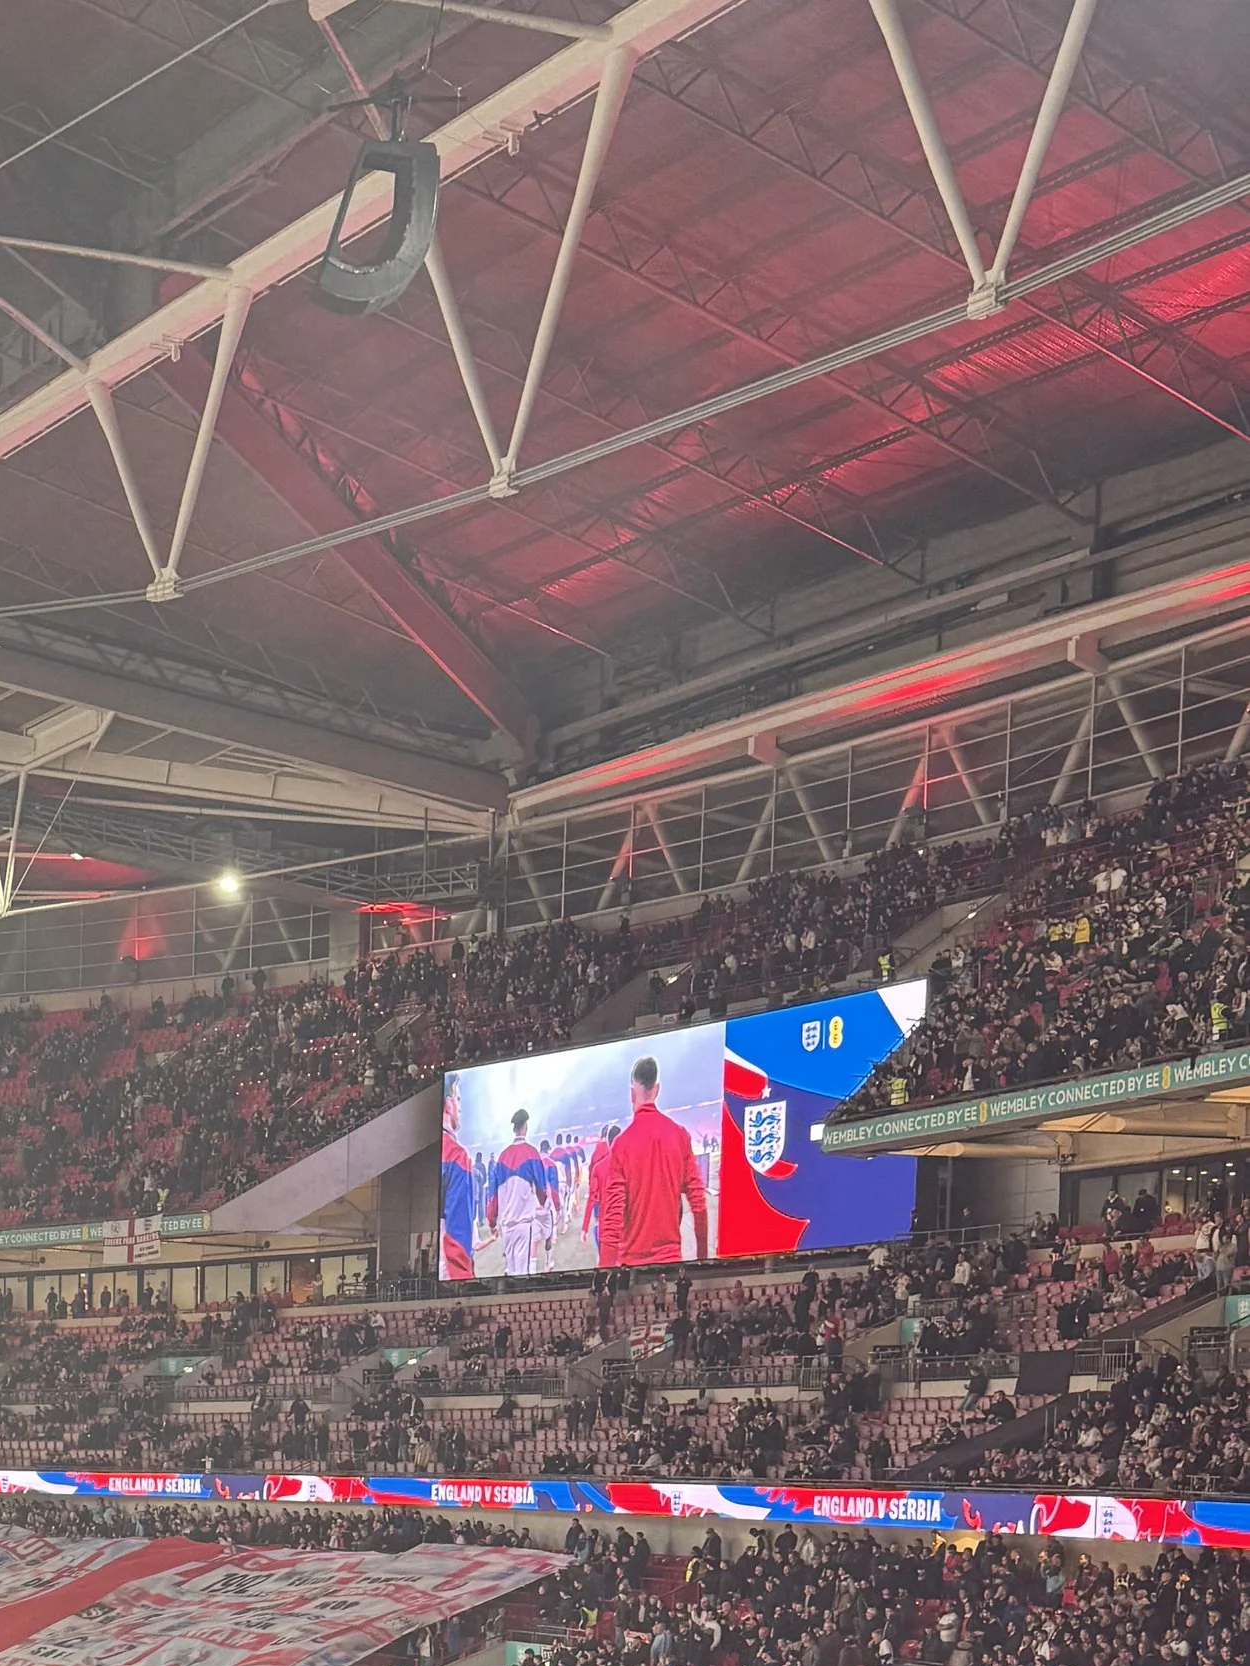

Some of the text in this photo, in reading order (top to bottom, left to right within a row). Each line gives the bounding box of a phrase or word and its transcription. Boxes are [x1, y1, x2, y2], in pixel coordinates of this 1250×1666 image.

[1174, 1056, 1236, 1083] WEMBLEY
[990, 1072, 1160, 1117] WEMBLEY CONNECTED BY EE
[823, 1106, 977, 1146] WEMBLEY CONNECTED BY EE
[180, 1218, 191, 1229] BY
[192, 1217, 202, 1228] EE
[10, 1230, 59, 1243] CONNECTED
[60, 1229, 71, 1239] BY
[72, 1228, 81, 1238] EE
[109, 1477, 201, 1493] ENGLAND V SERBIA
[431, 1484, 535, 1504] ENGLAND V SERBIA
[814, 1495, 941, 1522] ENGLAND V SERBIA
